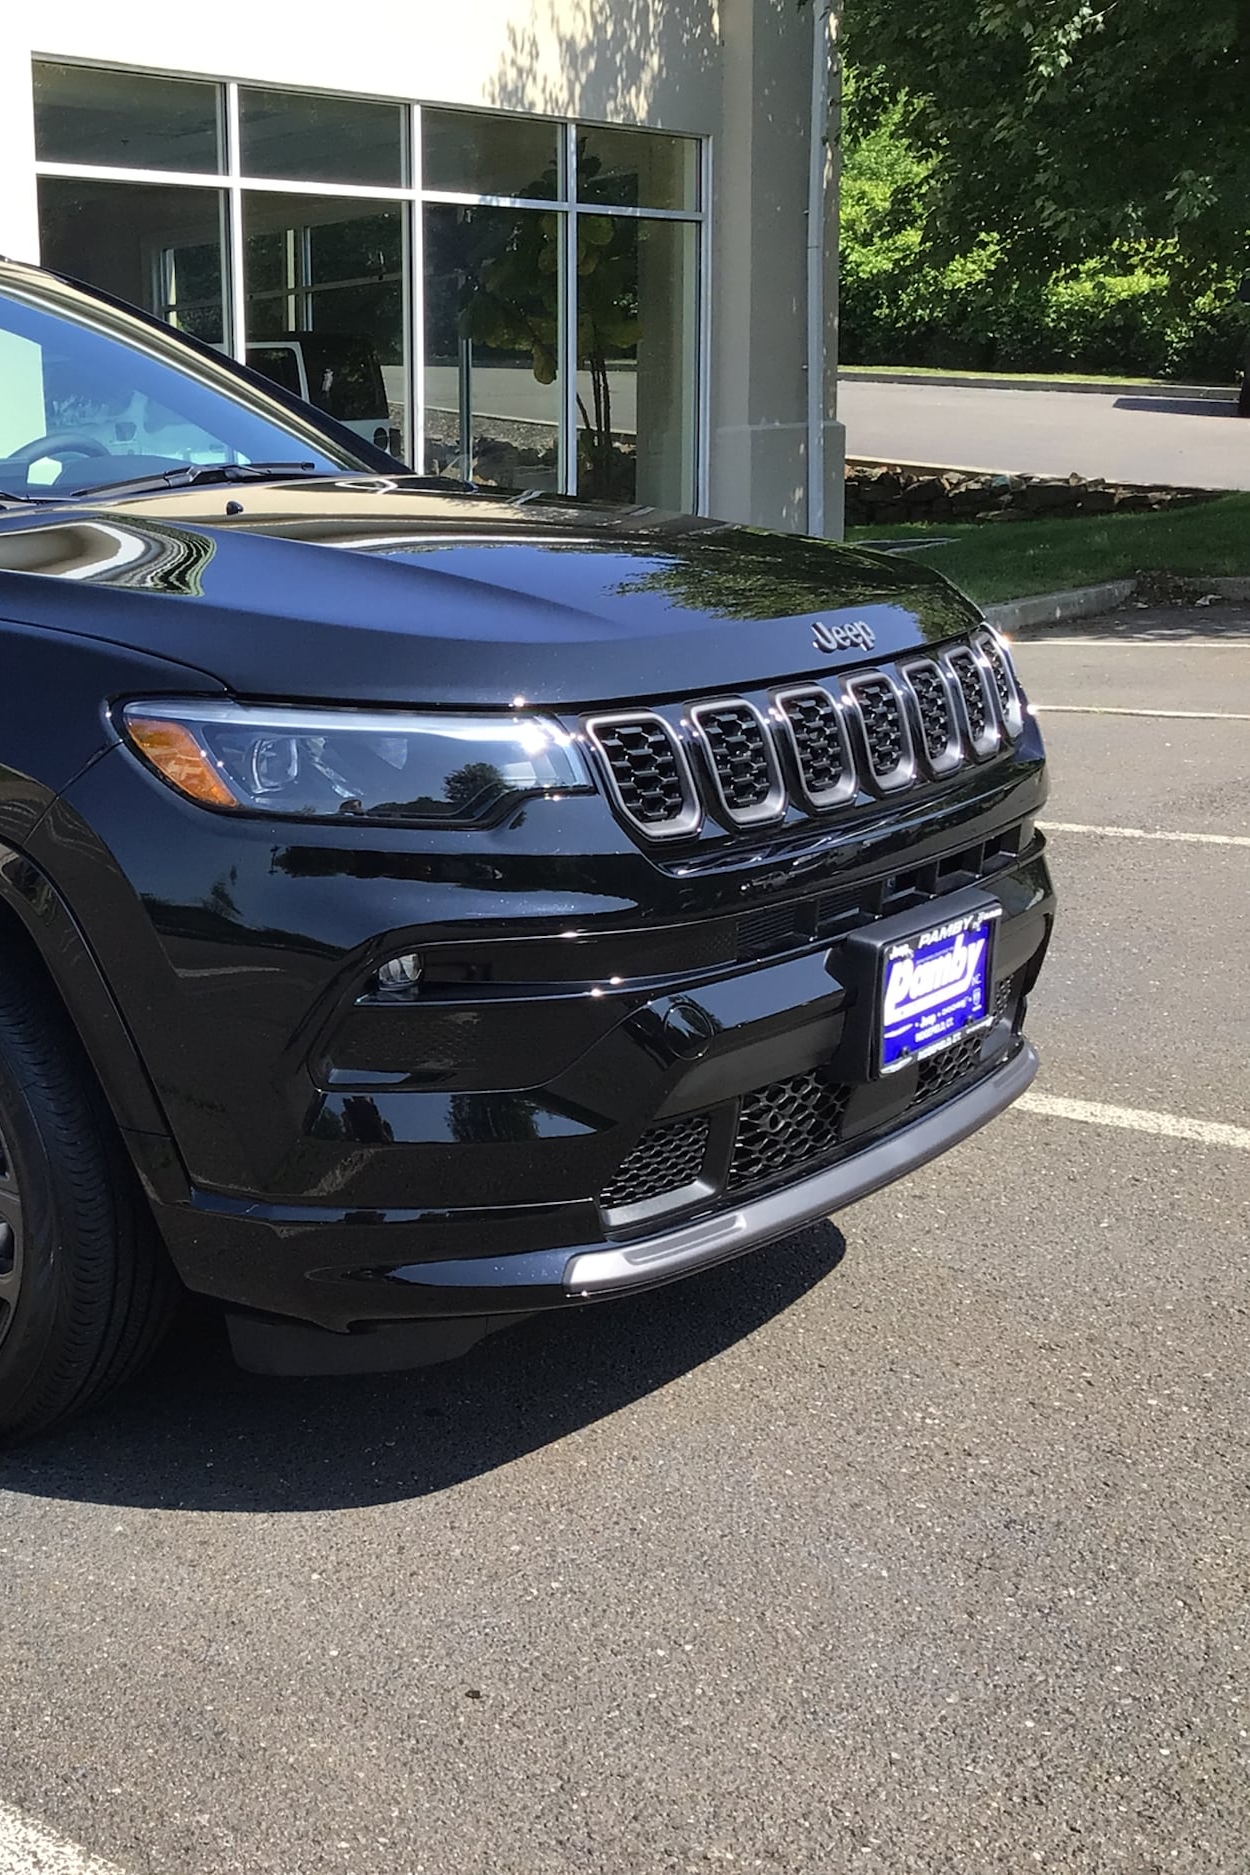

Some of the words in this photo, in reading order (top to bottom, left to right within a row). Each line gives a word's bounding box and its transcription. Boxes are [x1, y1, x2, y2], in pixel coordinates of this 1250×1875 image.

[811, 620, 876, 654] Jeep
[918, 915, 974, 949] PAMBY
[884, 934, 986, 1027] Pamby
